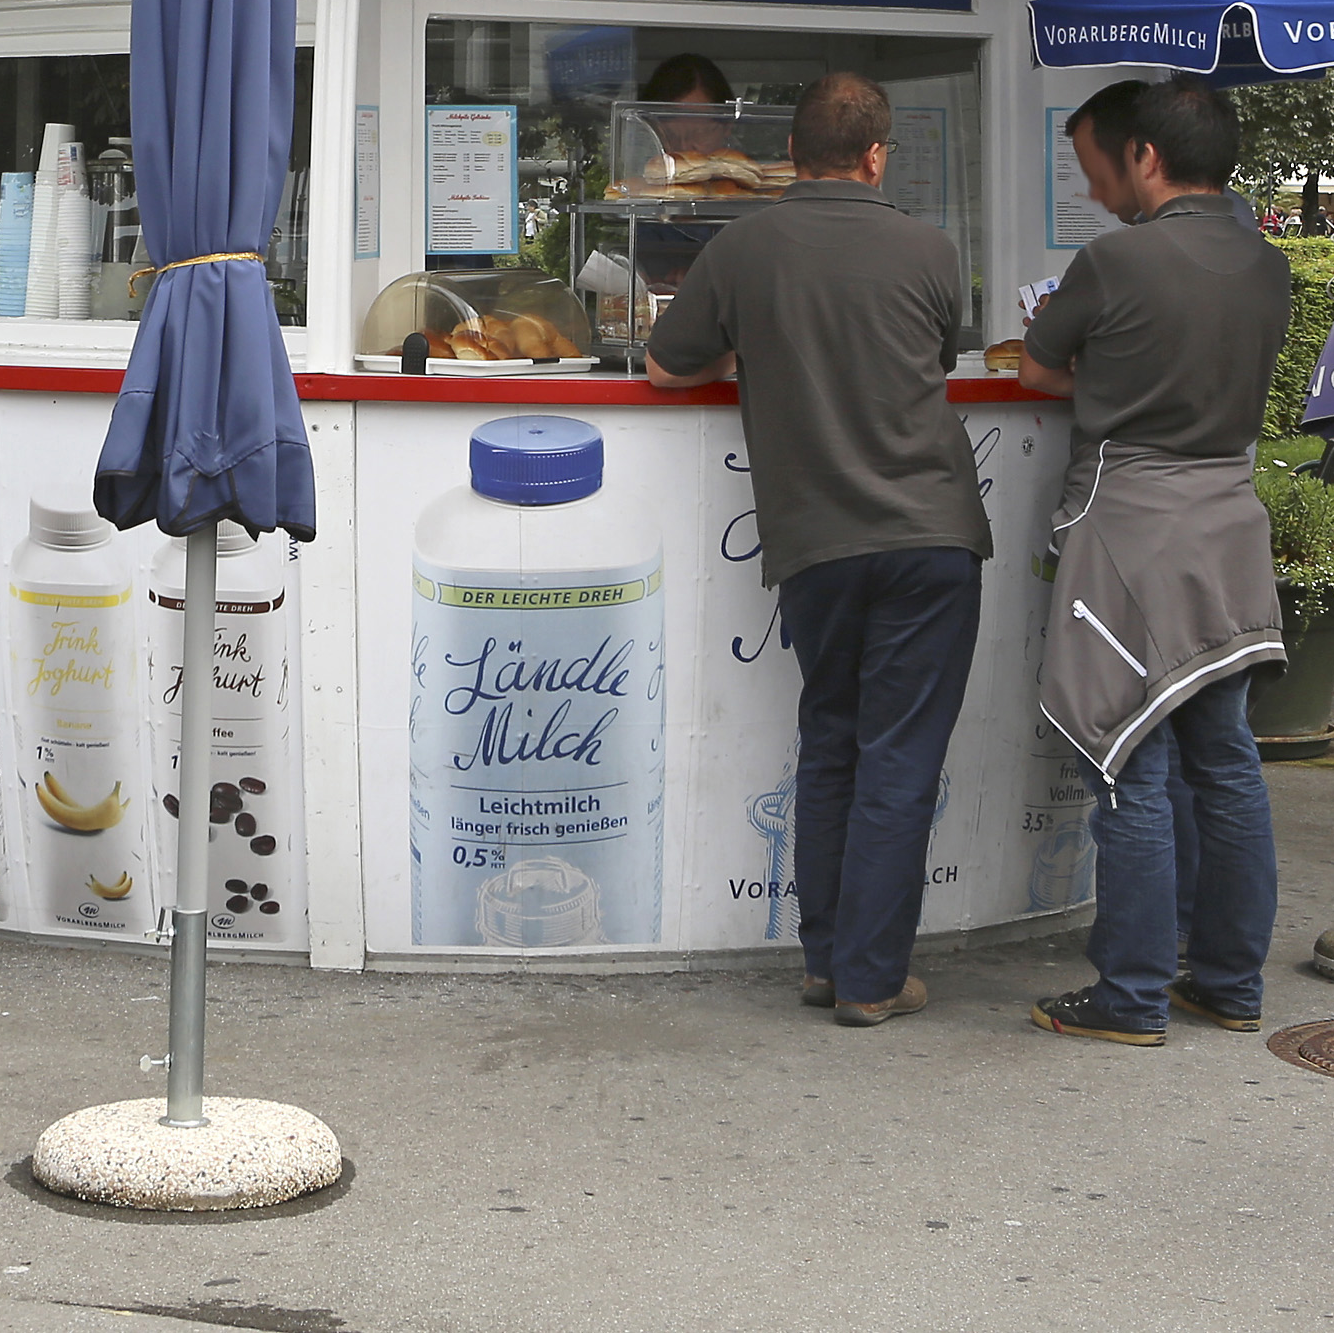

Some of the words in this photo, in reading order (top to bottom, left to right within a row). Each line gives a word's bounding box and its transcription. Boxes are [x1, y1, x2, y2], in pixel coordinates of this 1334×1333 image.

[462, 591, 495, 604] DER
[502, 592, 572, 605] LEICHTE
[578, 588, 624, 603] DREH
[230, 604, 254, 613] DREH
[43, 621, 102, 656] Trink
[214, 627, 251, 663] ink
[27, 658, 115, 696] Joghurt
[163, 664, 266, 704] Jhurt
[444, 635, 635, 714] Ländle
[213, 727, 234, 738] ffee
[453, 698, 619, 771] Milch
[1060, 764, 1079, 779] fris
[479, 795, 601, 815] Leichtmilch
[450, 816, 501, 838] länger
[506, 822, 550, 835] frisch
[555, 815, 628, 838] genießen
[208, 931, 264, 939] RLBERGMILCH
